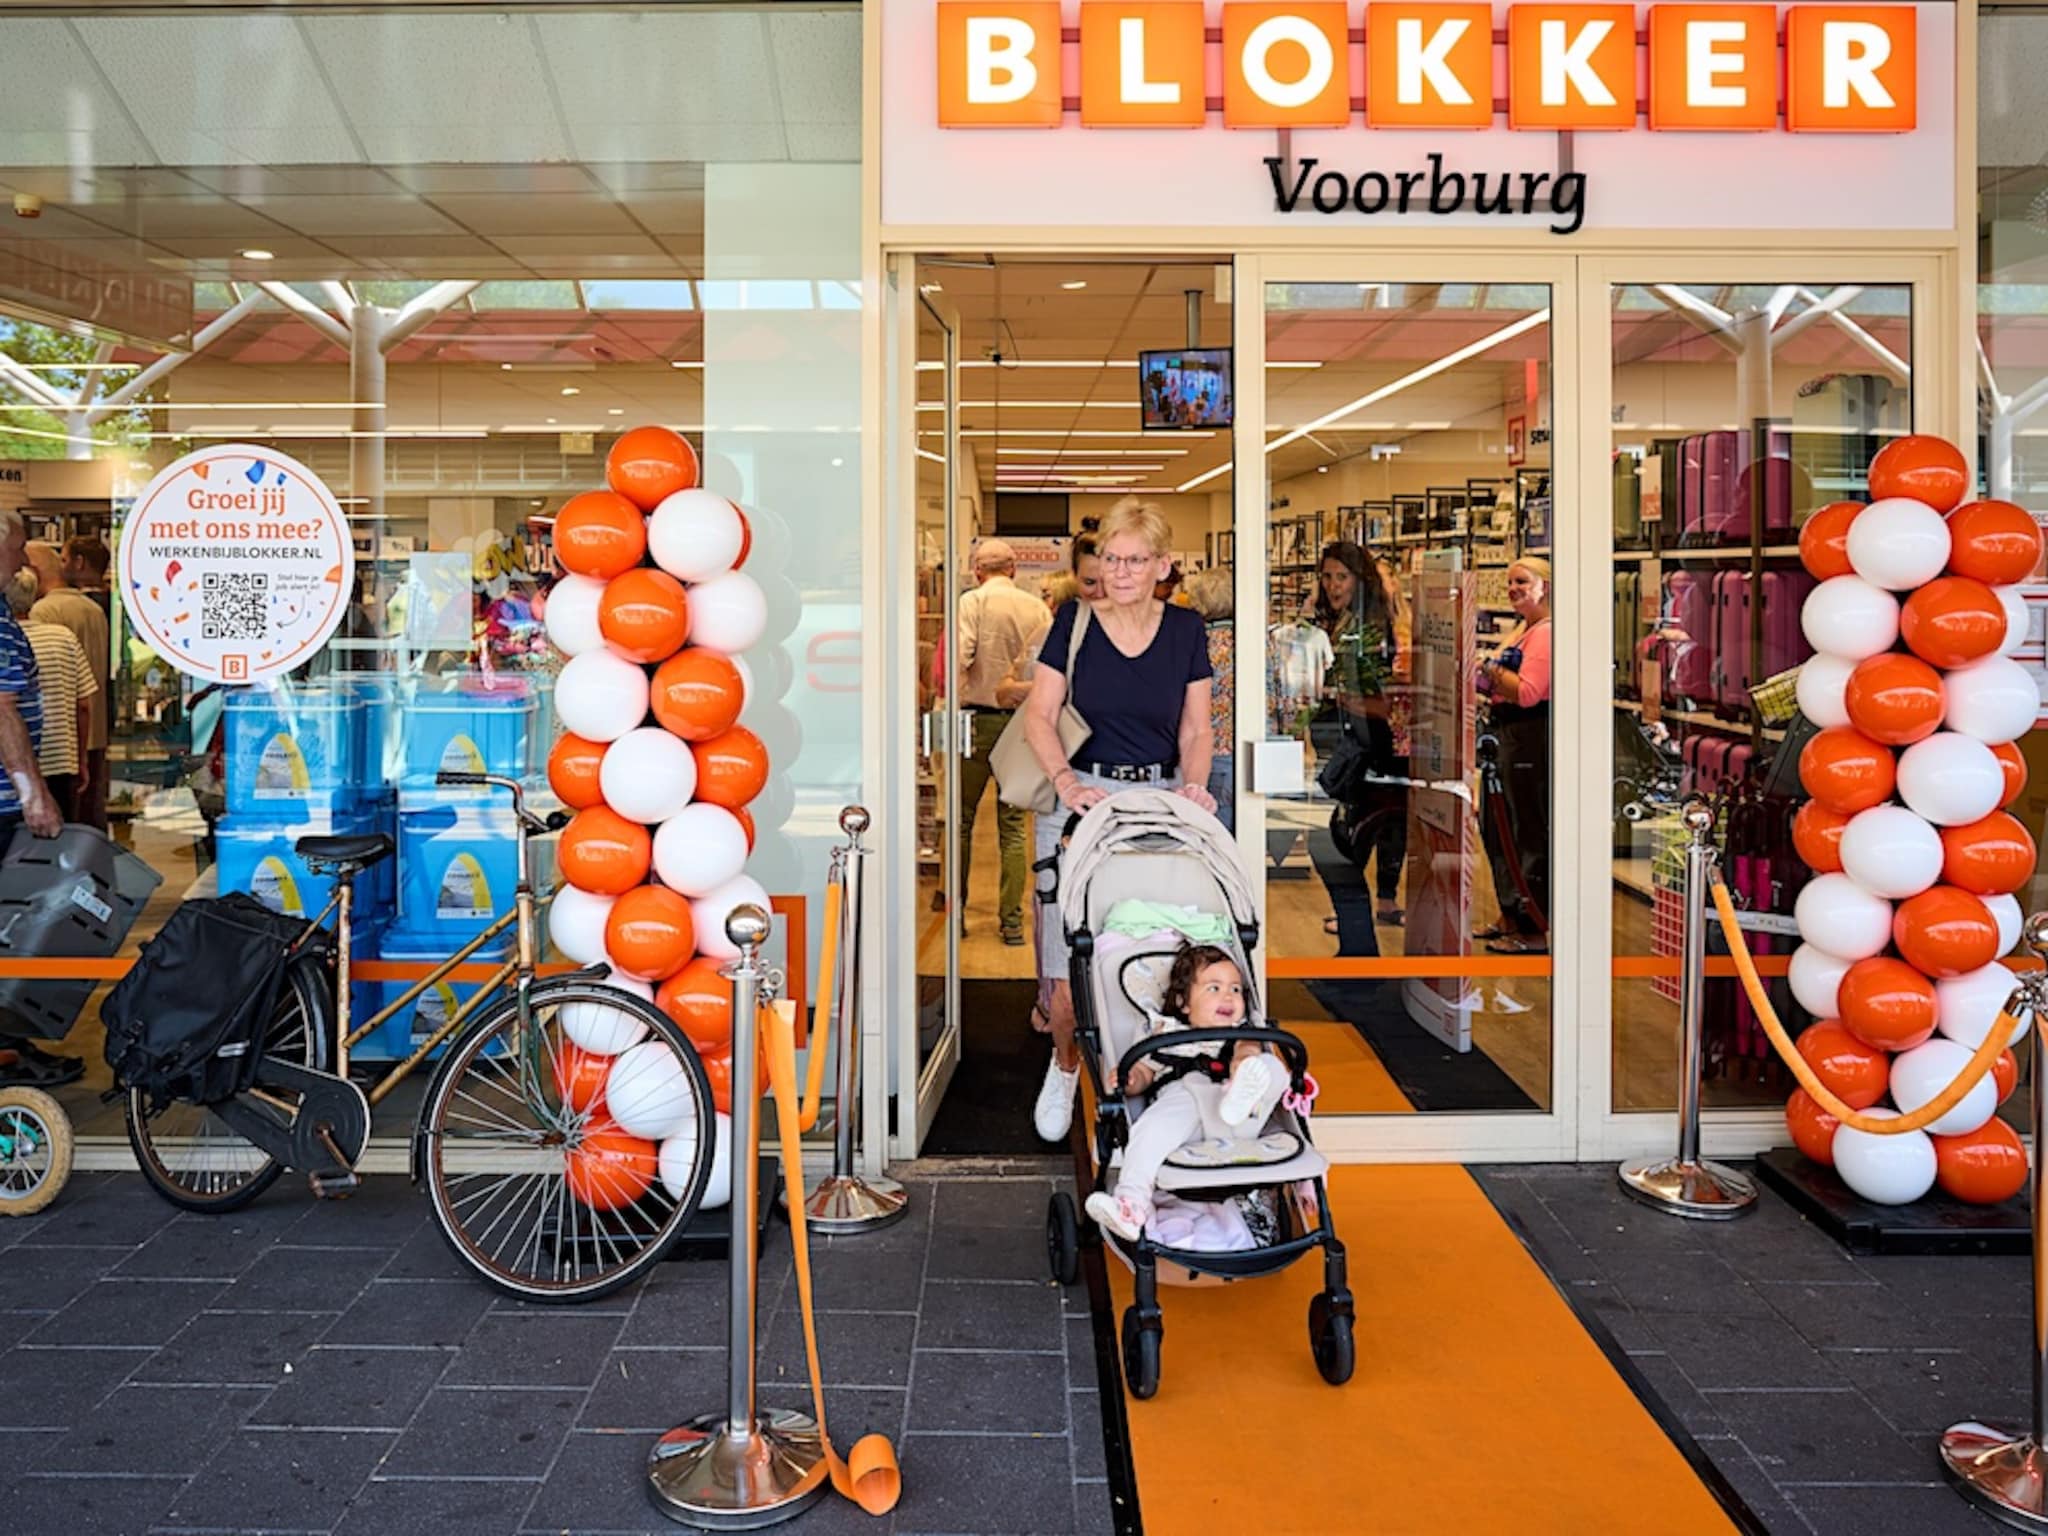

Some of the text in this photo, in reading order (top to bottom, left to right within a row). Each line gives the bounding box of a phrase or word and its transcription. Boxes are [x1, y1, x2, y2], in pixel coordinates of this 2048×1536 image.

[966, 15, 1896, 108] BLOKKER
[1263, 153, 1586, 235] Voorburg
[187, 488, 286, 516] Groei jij
[149, 518, 323, 539] met ons mee?
[149, 546, 323, 559] WERKENBIJBLOKKER.NL
[229, 660, 240, 674] B
